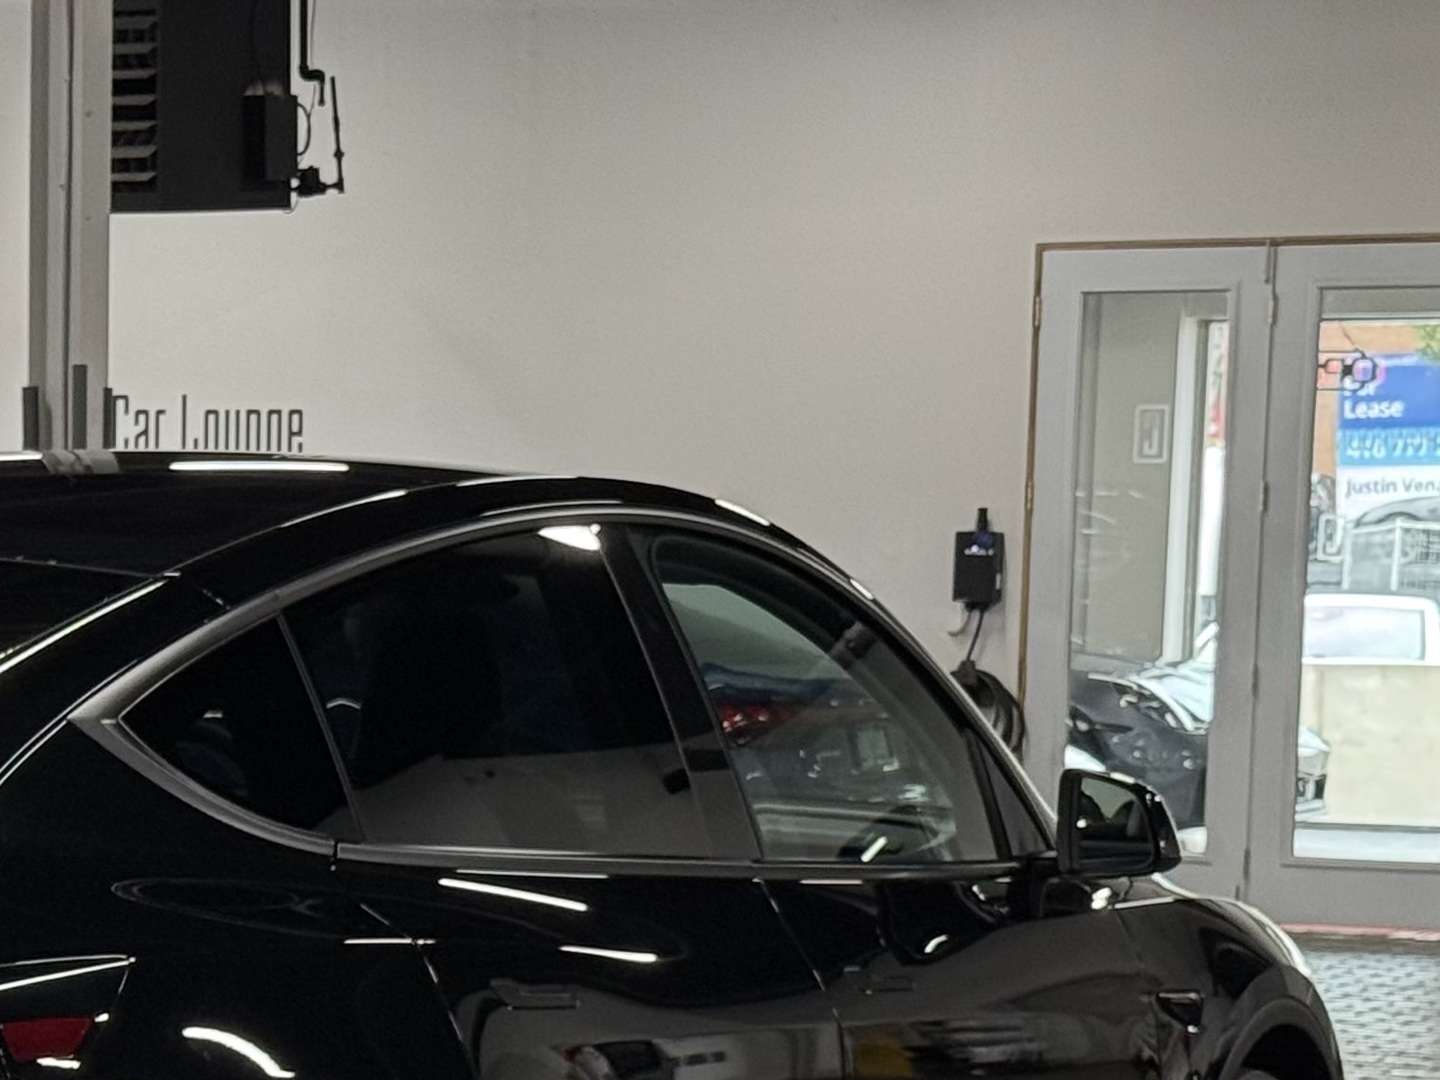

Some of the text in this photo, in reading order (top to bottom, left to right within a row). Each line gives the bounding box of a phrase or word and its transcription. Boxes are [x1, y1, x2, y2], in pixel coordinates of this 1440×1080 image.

[1343, 400, 1405, 420] Lease
[111, 394, 167, 449] Car
[1344, 476, 1398, 498] Justin
